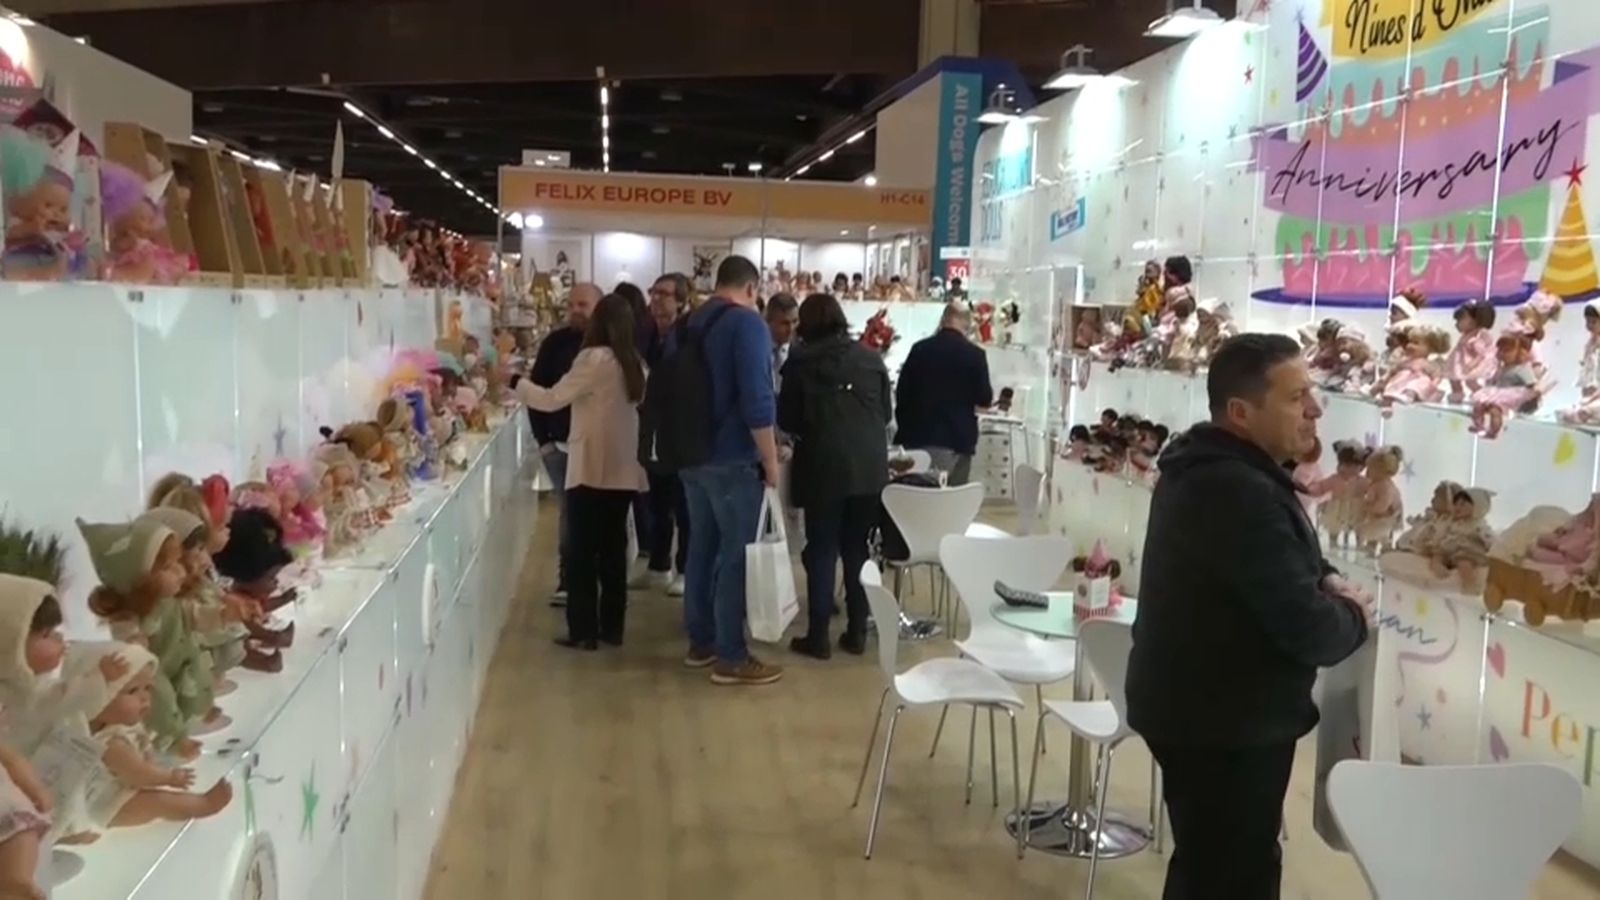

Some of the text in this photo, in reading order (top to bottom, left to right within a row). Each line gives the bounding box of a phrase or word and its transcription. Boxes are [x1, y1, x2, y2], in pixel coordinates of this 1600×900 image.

[1345, 0, 1407, 54] Nines
[955, 84, 968, 110] All
[1271, 119, 1579, 205] Anniversary
[535, 182, 732, 206] FELIX EUROPE BV
